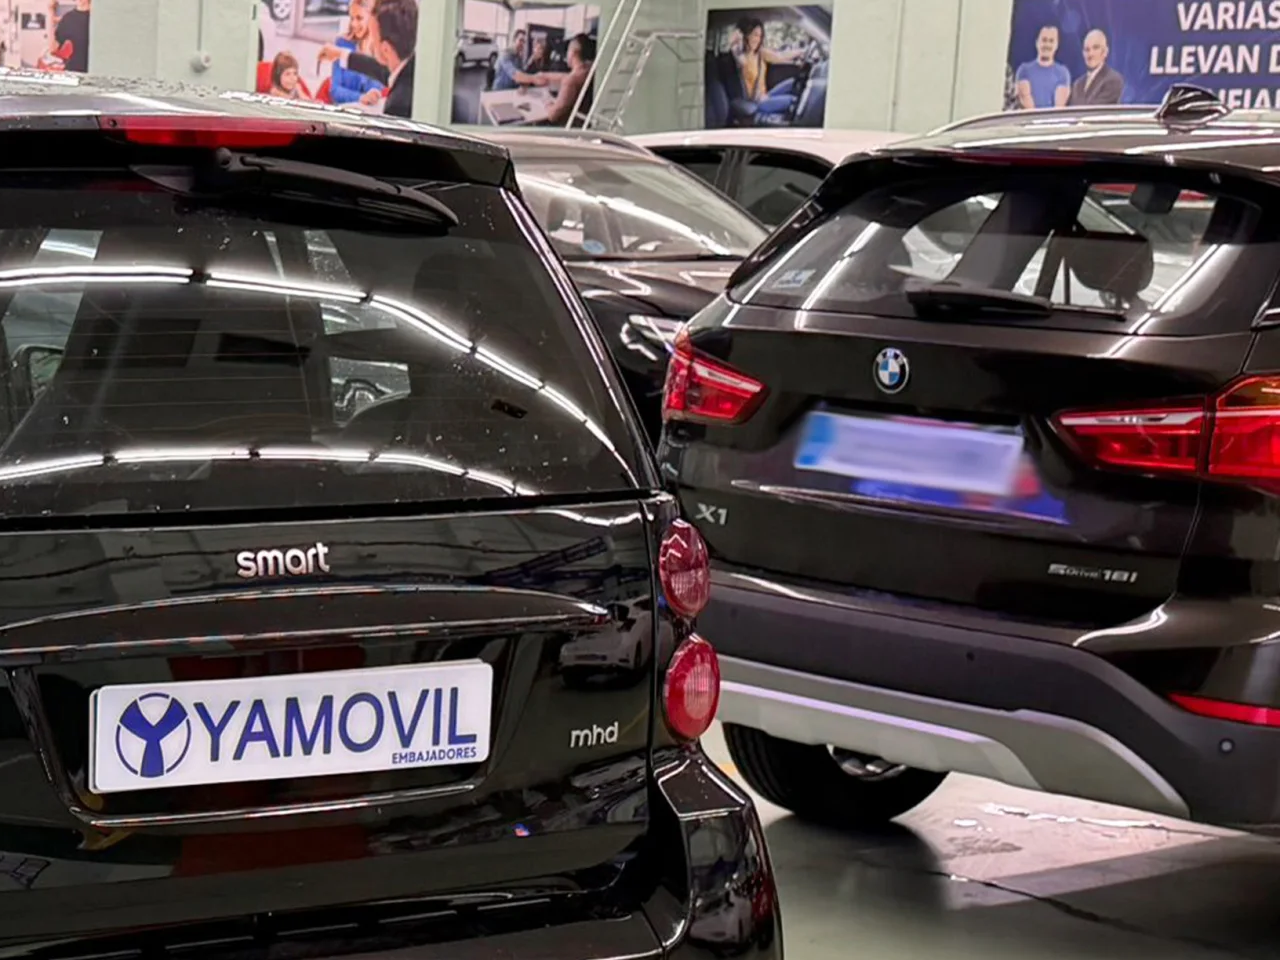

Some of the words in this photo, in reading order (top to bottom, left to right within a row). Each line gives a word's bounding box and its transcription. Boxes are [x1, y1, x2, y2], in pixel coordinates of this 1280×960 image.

[1177, 1, 1280, 31] VARIAS
[1149, 44, 1260, 74] LLEVAN
[695, 502, 728, 526] X1
[236, 541, 330, 578] smart
[192, 686, 478, 763] YAMOVIL
[570, 720, 619, 748] mhd
[391, 746, 478, 765] EMBAJADORES
